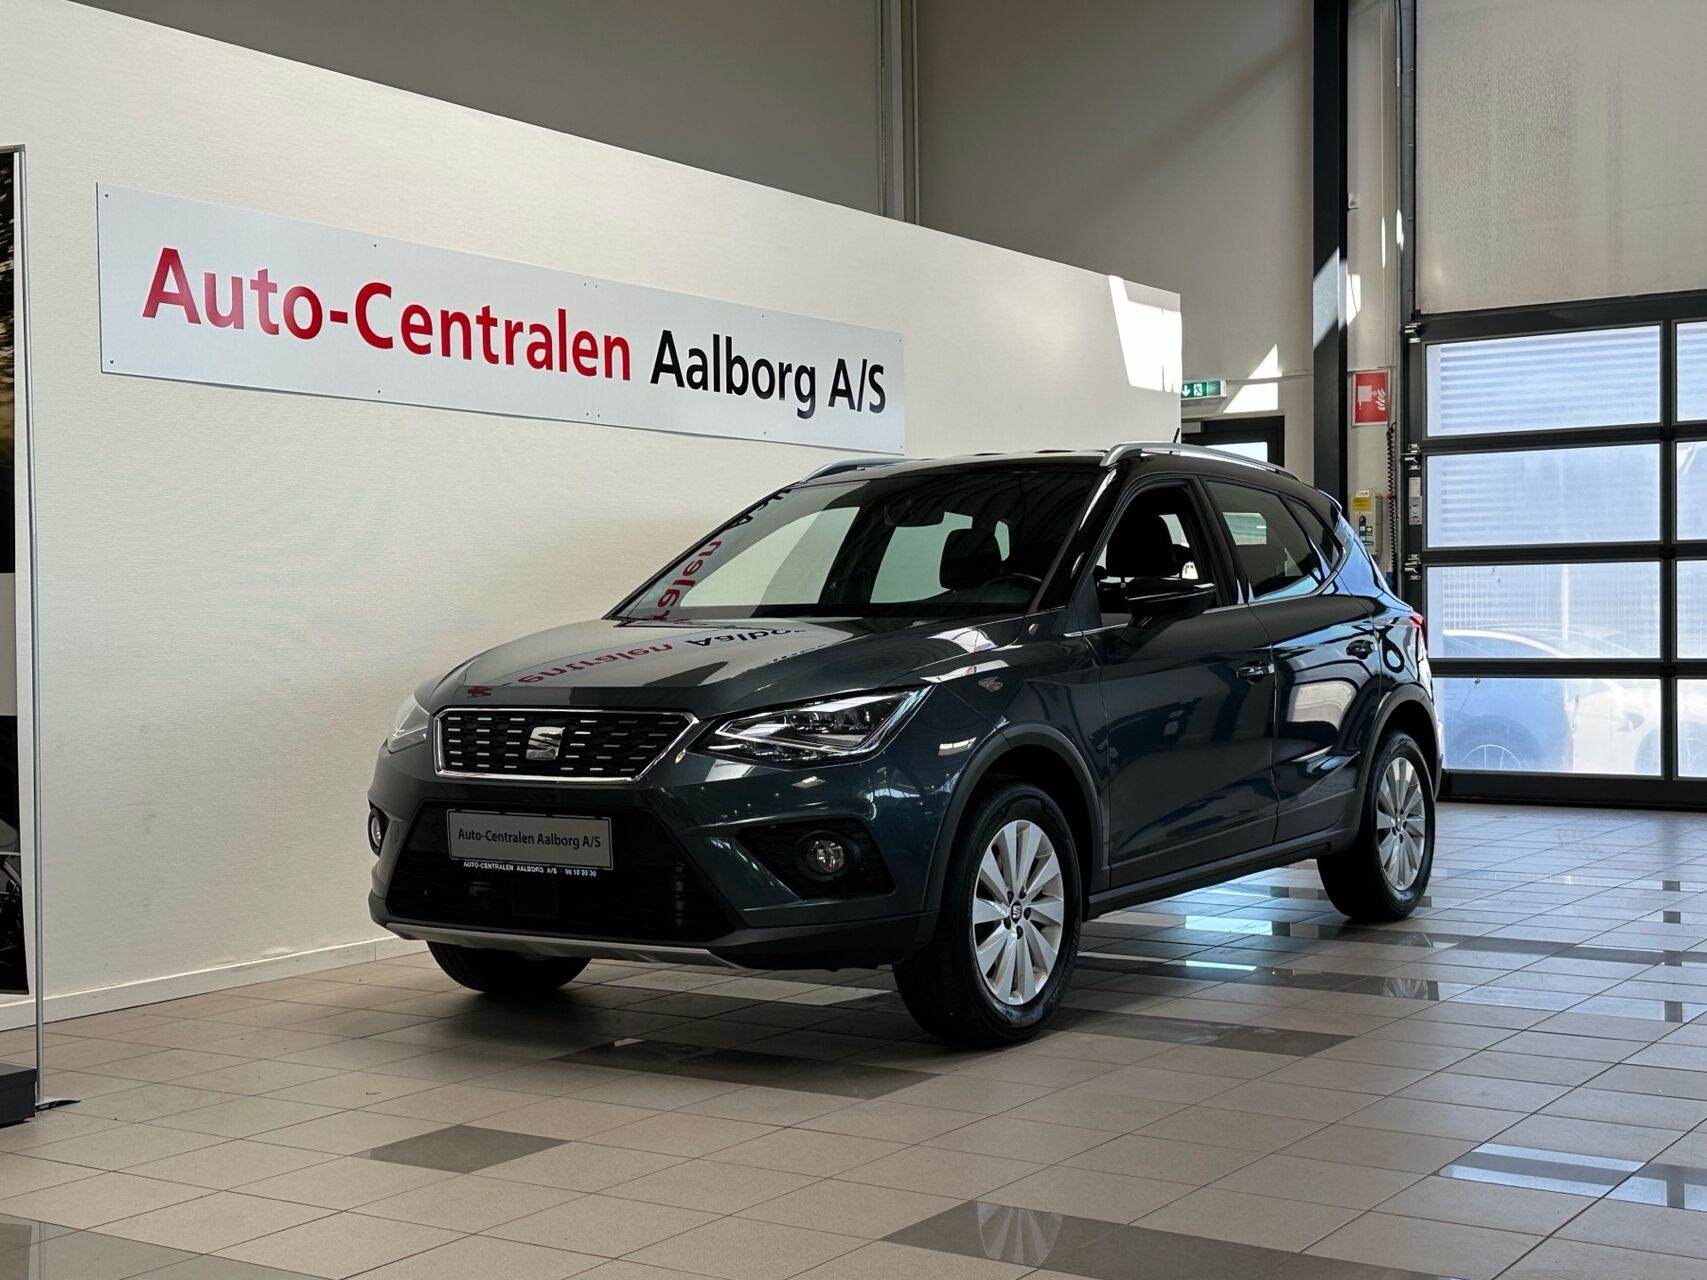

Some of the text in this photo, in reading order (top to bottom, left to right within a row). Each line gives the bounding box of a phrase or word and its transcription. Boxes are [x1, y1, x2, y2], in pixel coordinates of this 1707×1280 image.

[143, 246, 887, 419] Auto-Centralen Aalborg A/S
[457, 828, 601, 849] Auto-Centralen Aalborg A/S
[463, 861, 514, 871] AUTO-CENTRALEN
[516, 865, 544, 874] AALBORG
